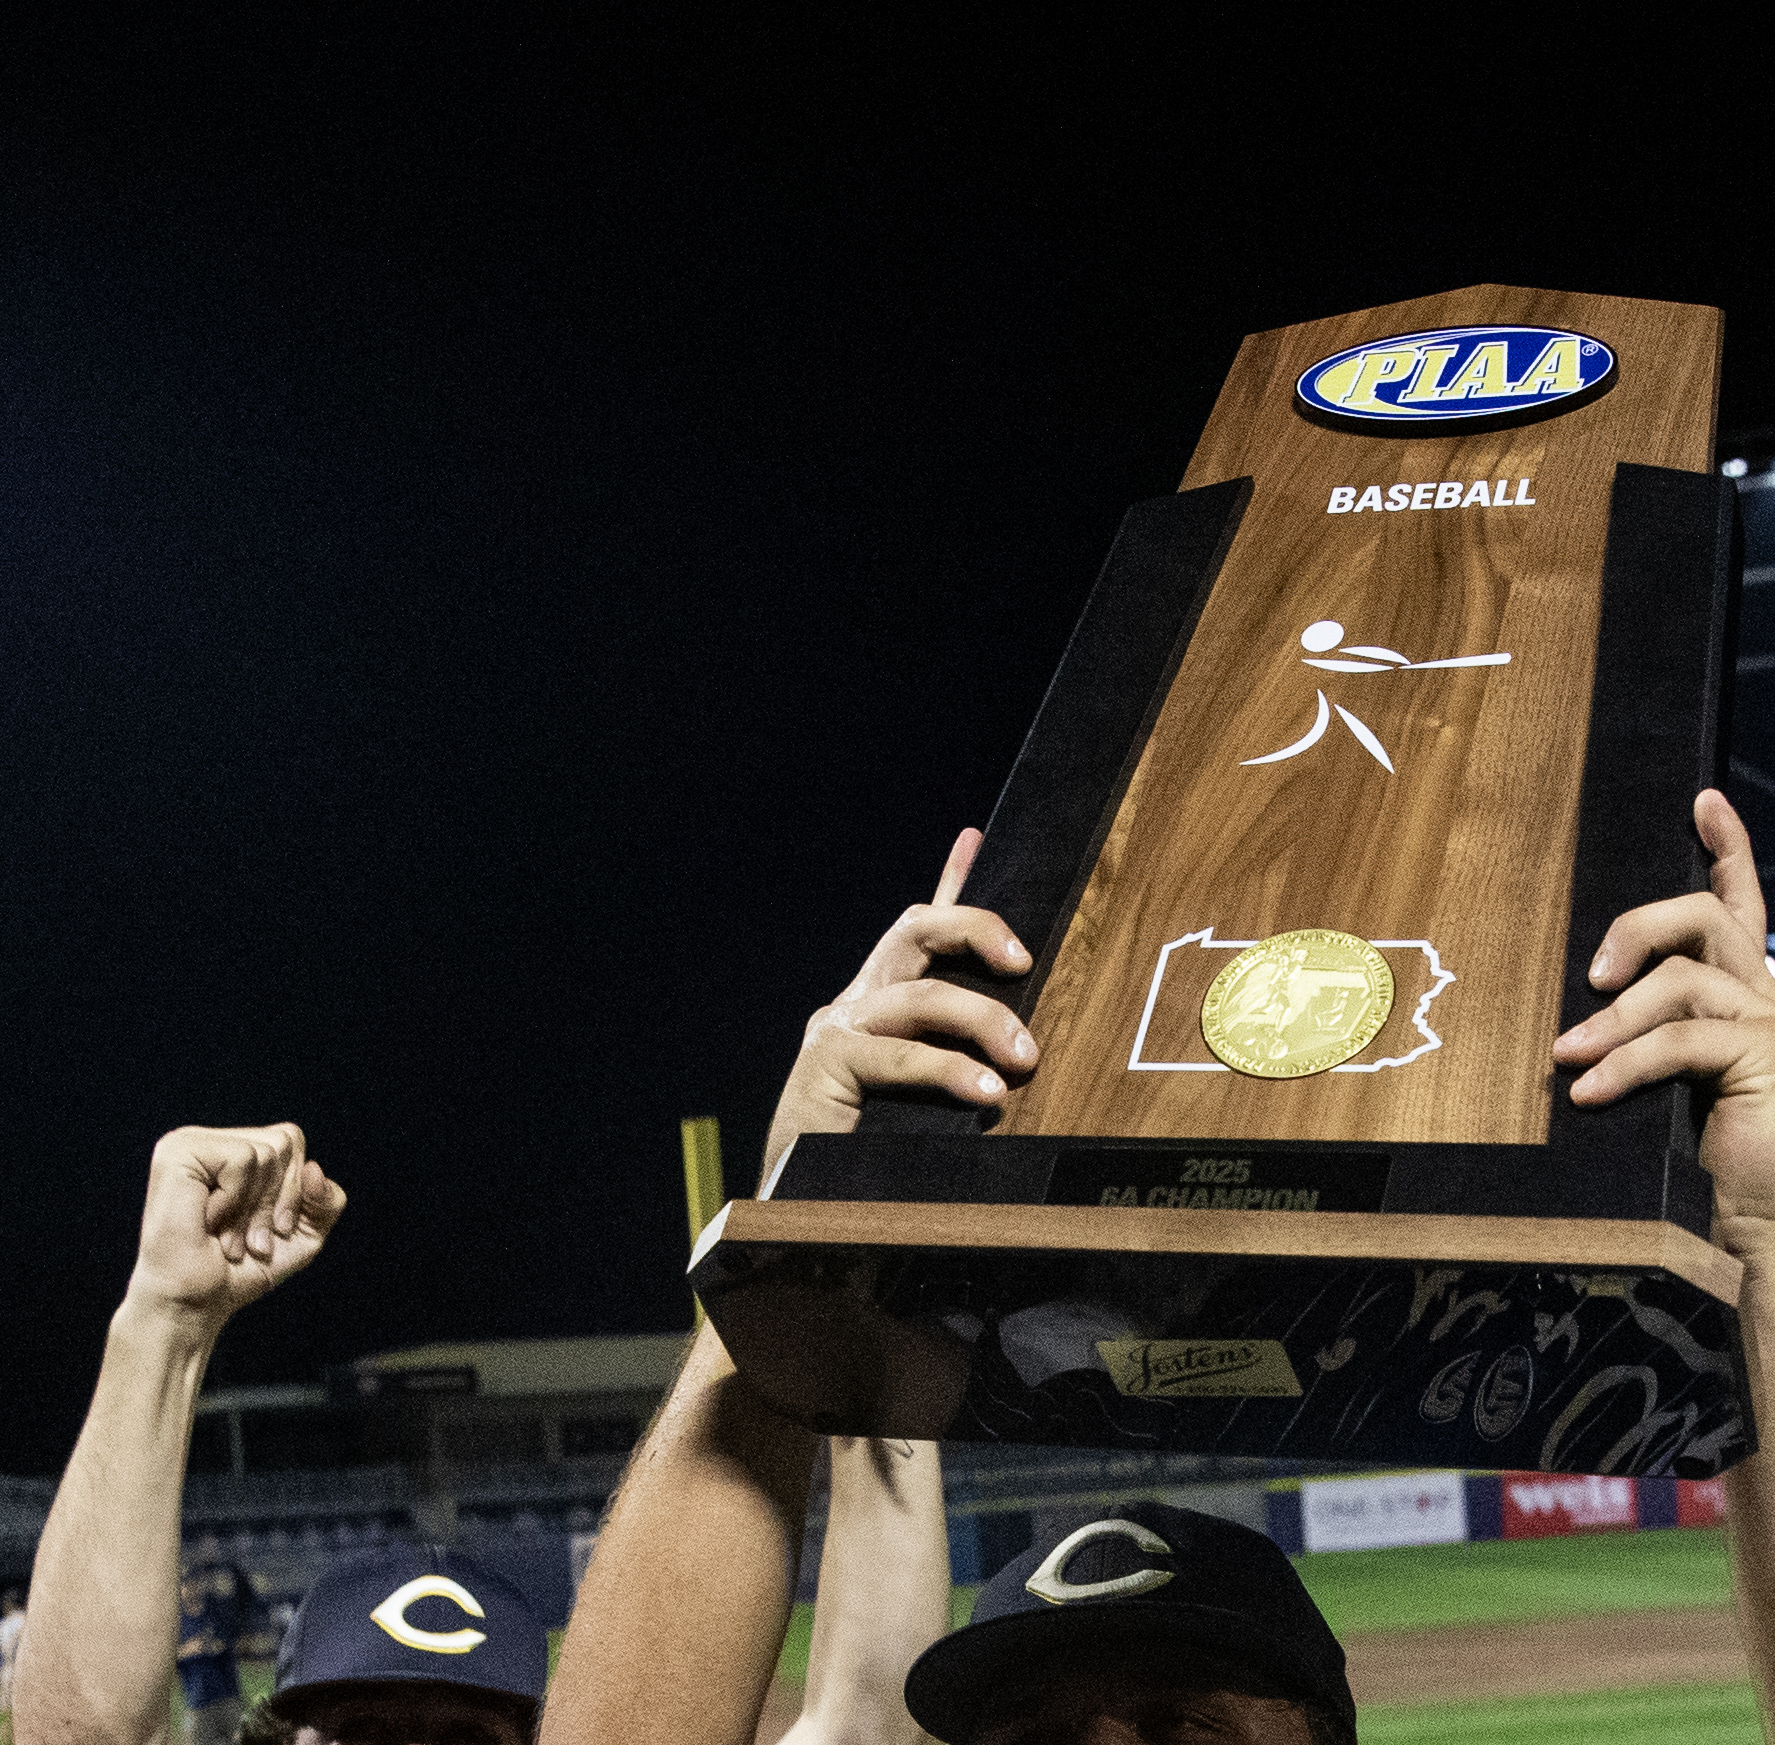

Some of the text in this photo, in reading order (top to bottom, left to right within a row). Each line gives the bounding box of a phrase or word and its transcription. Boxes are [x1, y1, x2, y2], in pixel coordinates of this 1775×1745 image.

[1337, 338, 1584, 406] PIAA
[1327, 478, 1536, 514] BASEBALL
[1180, 1158, 1252, 1184] 2025
[1100, 1186, 1320, 1212] 6A CHAMPION
[1025, 1518, 1176, 1605] C
[370, 1574, 487, 1655] C
